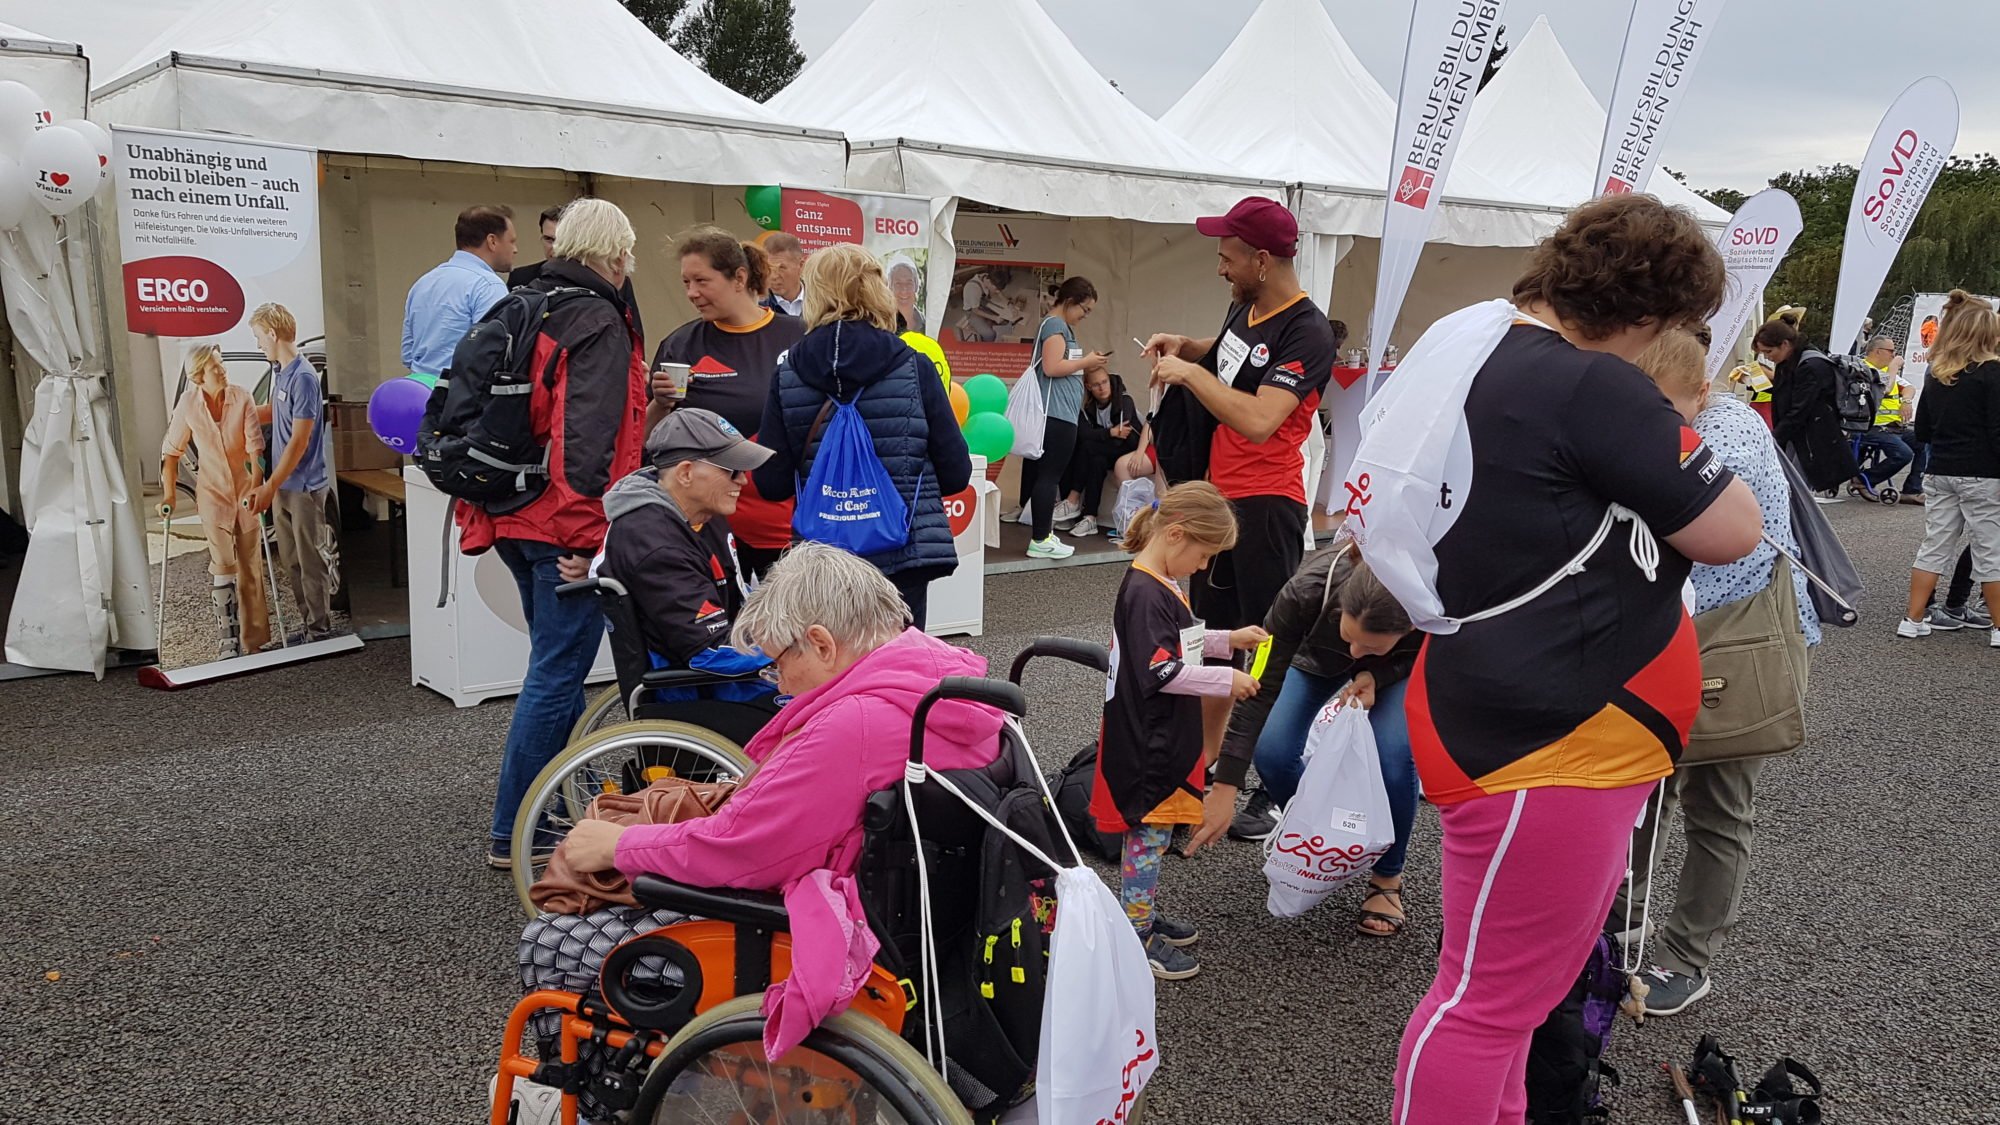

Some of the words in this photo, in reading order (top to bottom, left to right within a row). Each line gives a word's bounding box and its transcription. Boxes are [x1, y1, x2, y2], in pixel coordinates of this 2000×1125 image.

[1425, 72, 1473, 171] BREMEN
[1466, 0, 1500, 63] GMB
[1612, 0, 1693, 177] BERUFSBILDUNG
[1626, 95, 1670, 183] BREMEN
[1665, 21, 1703, 88] GMBH
[127, 144, 232, 171] Unabhängig
[235, 157, 267, 171] und
[39, 169, 48, 182] I
[129, 166, 182, 183] mobil
[184, 169, 247, 188] bleiben
[262, 178, 300, 193] auch
[1864, 129, 1918, 222] SoVD
[35, 181, 72, 194] Vielfalt
[1880, 141, 1931, 232] Sozialverband
[1888, 147, 1938, 238] Deutschland
[131, 187, 175, 202] nach
[178, 189, 231, 207] einem
[234, 193, 289, 211] Unfall.
[133, 209, 159, 219] Danke
[161, 210, 176, 219] fürs
[177, 211, 203, 221] Fahren
[205, 214, 219, 223] und
[220, 214, 231, 223] die
[232, 216, 255, 225] vielen
[256, 217, 288, 226] weiteren
[795, 208, 823, 220] Ganz
[134, 221, 195, 234] Hilfeleistungen.
[196, 225, 208, 233] Die
[209, 226, 298, 240] Volks-Unfallversicherung
[795, 223, 852, 237] entspannt
[875, 217, 919, 236] ERGO
[1732, 227, 1779, 245] SoVD
[135, 234, 150, 243] mit
[137, 278, 209, 302] ERGO
[1734, 283, 1760, 323] Gerechtigkeit
[943, 500, 965, 517] GO
[1342, 821, 1356, 829] 520
[1742, 1106, 1772, 1114] LEKI
